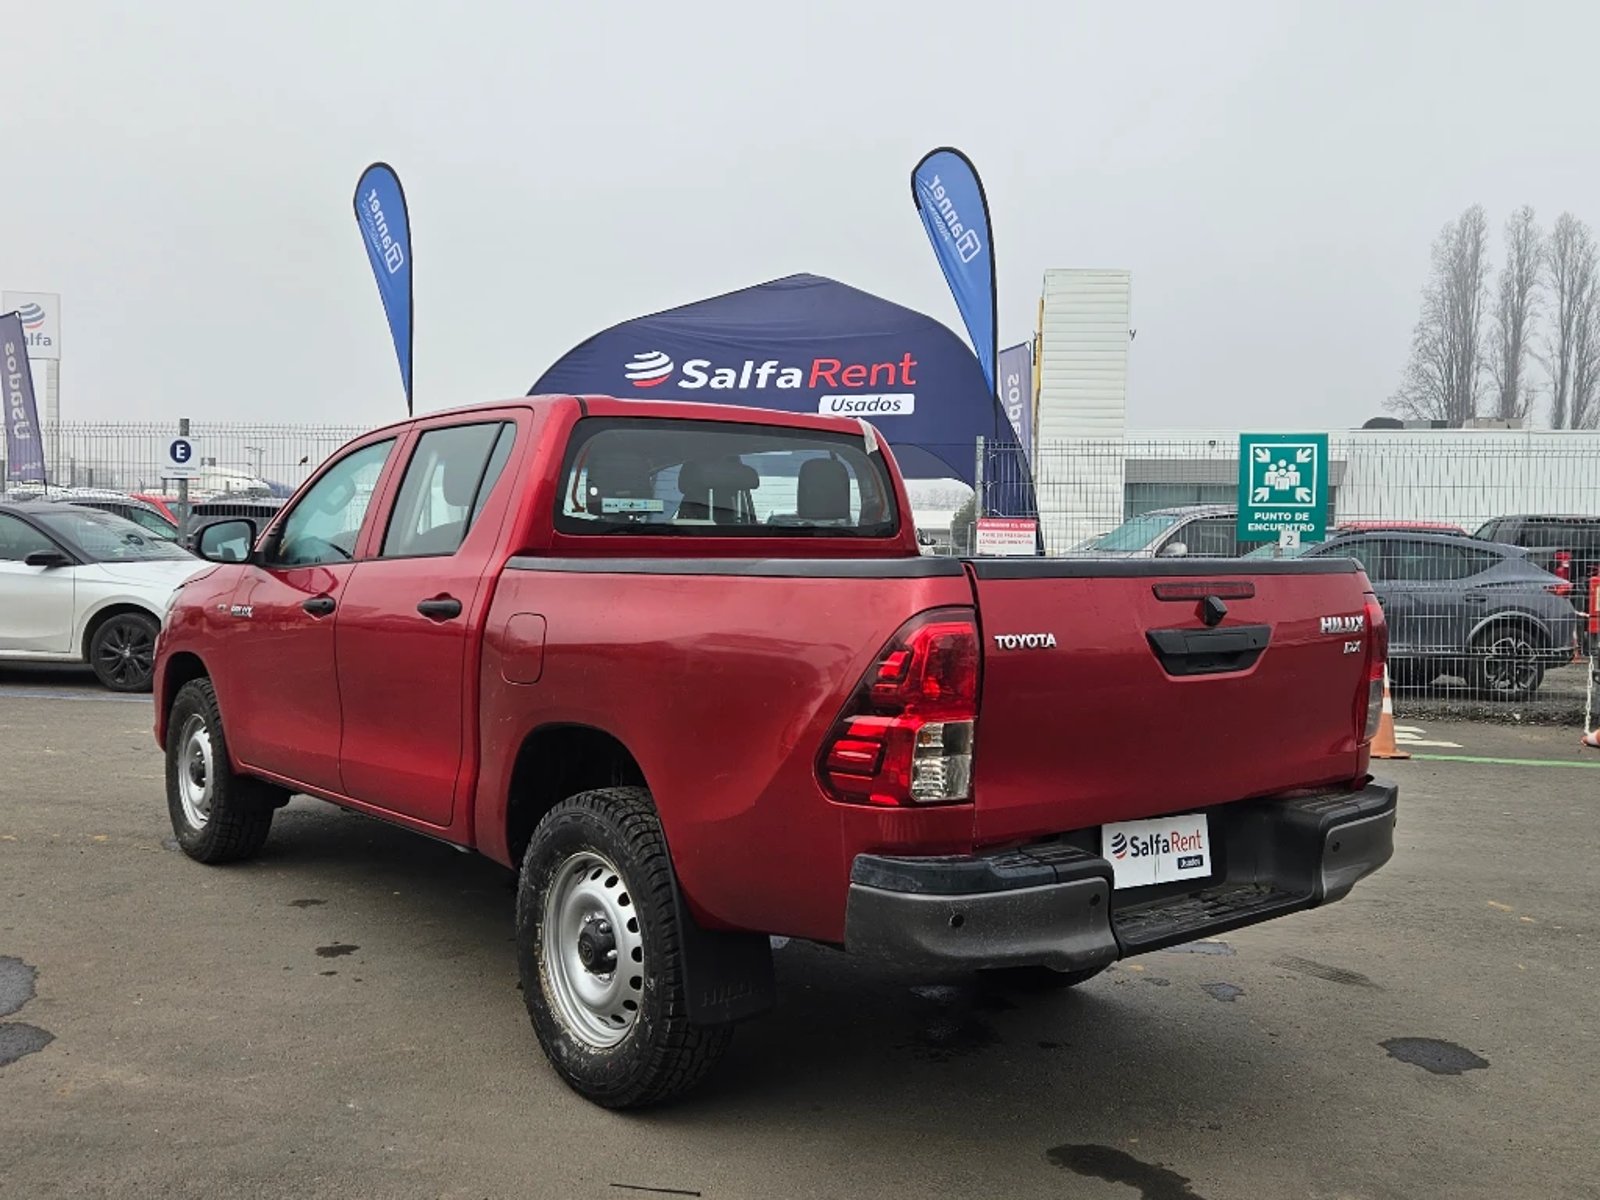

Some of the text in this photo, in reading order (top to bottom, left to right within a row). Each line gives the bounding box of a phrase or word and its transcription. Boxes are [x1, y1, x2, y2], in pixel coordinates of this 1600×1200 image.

[830, 396, 902, 413] Usados
[175, 444, 186, 459] E
[1254, 511, 1310, 521] PUNTO DE
[1247, 522, 1315, 532] ENCUENTRO
[1285, 535, 1294, 546] 2
[1320, 615, 1364, 634] HILUX
[994, 632, 1057, 649] TOYOTA
